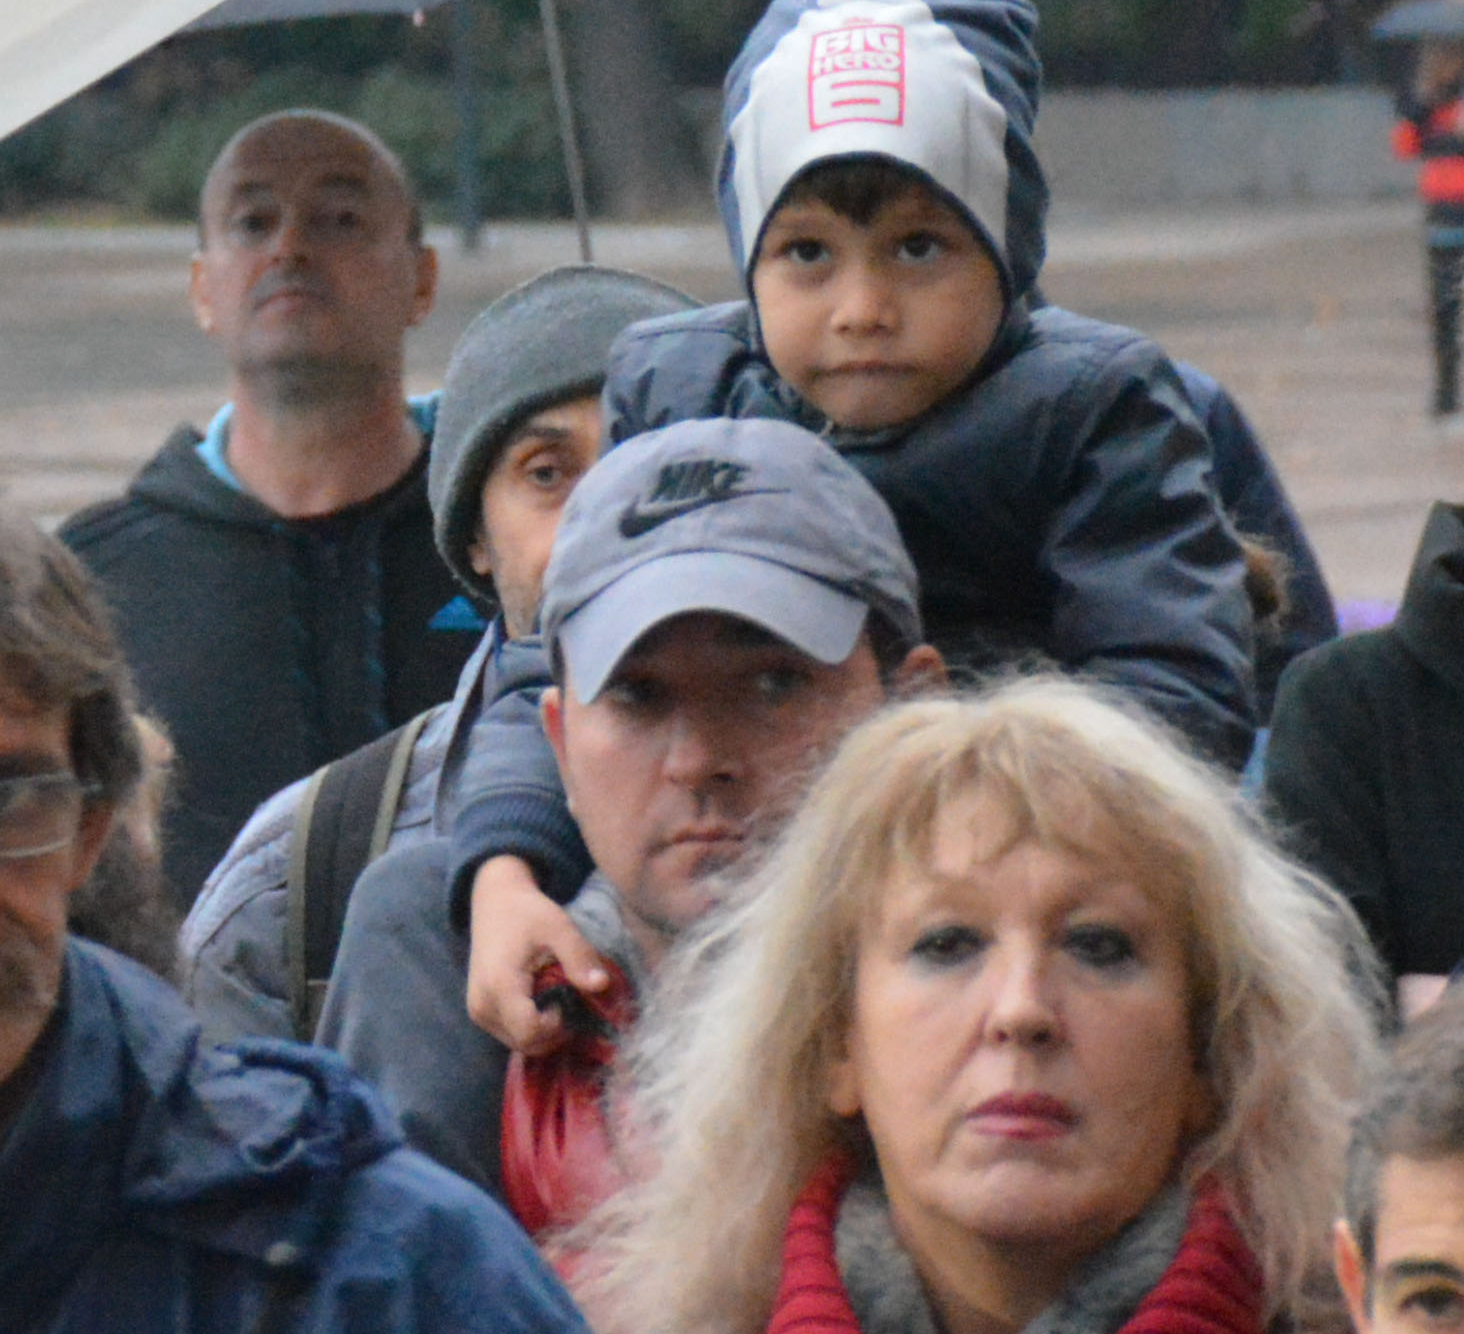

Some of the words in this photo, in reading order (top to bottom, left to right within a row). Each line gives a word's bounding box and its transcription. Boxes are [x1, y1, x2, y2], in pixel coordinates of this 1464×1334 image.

[815, 28, 900, 57] BIG
[813, 52, 901, 76] HERO
[813, 69, 902, 125] 6
